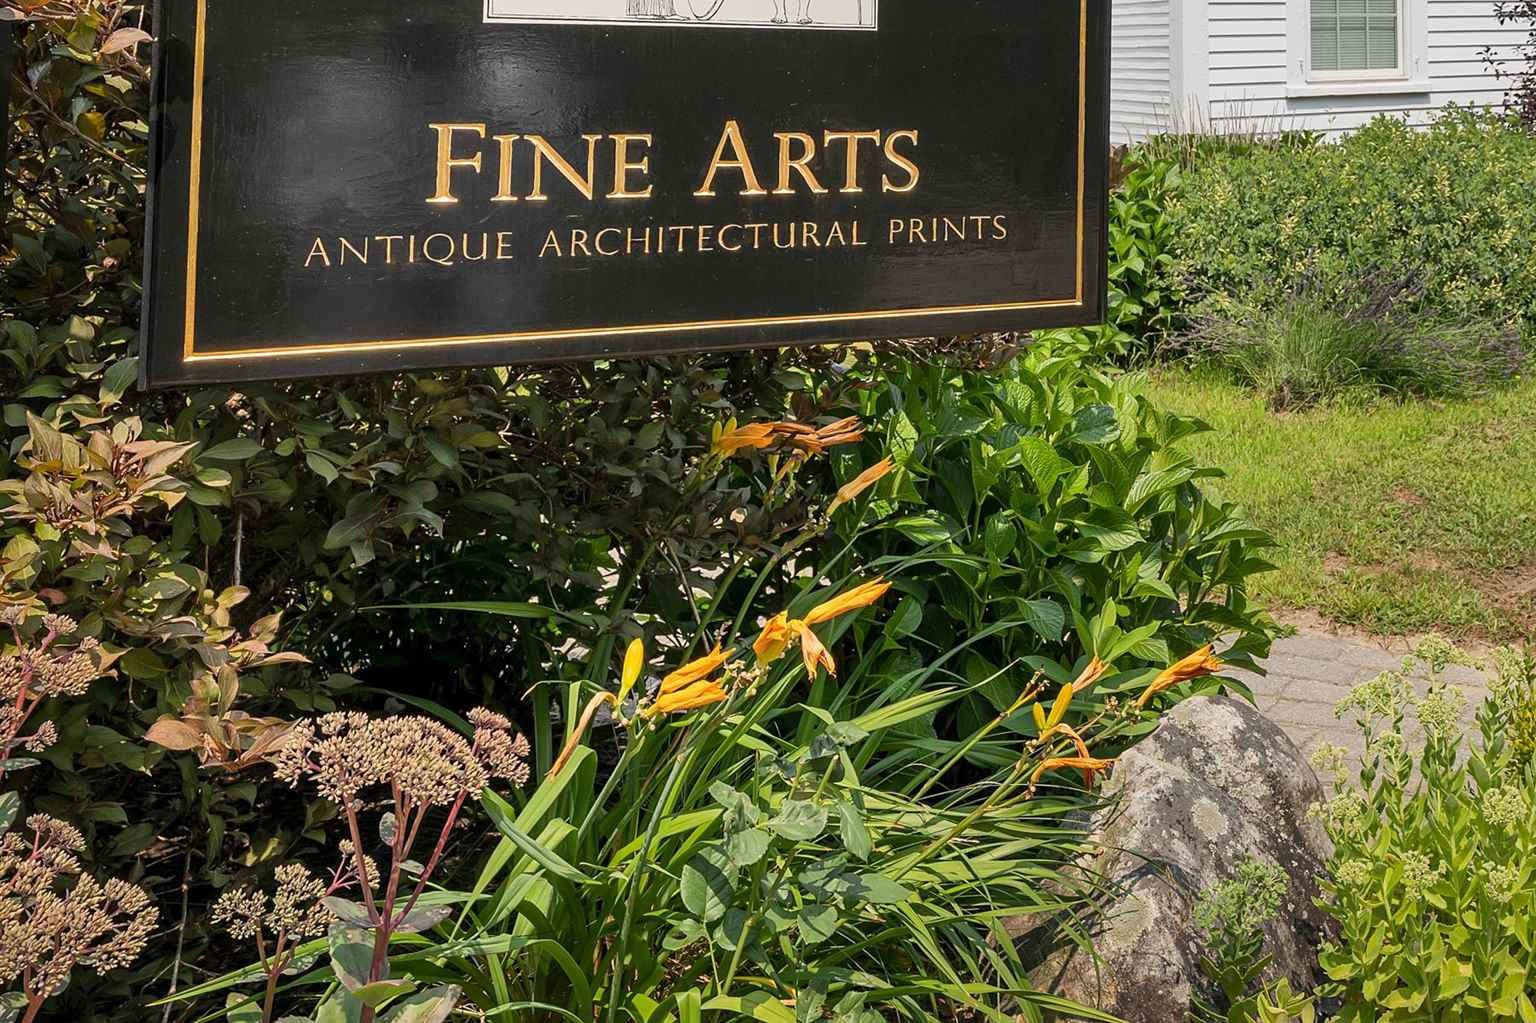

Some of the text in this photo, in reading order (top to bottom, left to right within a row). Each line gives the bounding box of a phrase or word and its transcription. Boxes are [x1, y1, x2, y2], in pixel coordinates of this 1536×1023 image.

[425, 120, 920, 204] FINE ARTS
[304, 214, 1008, 267] ANTIQUE ARCHITECTURAL PRINTS
